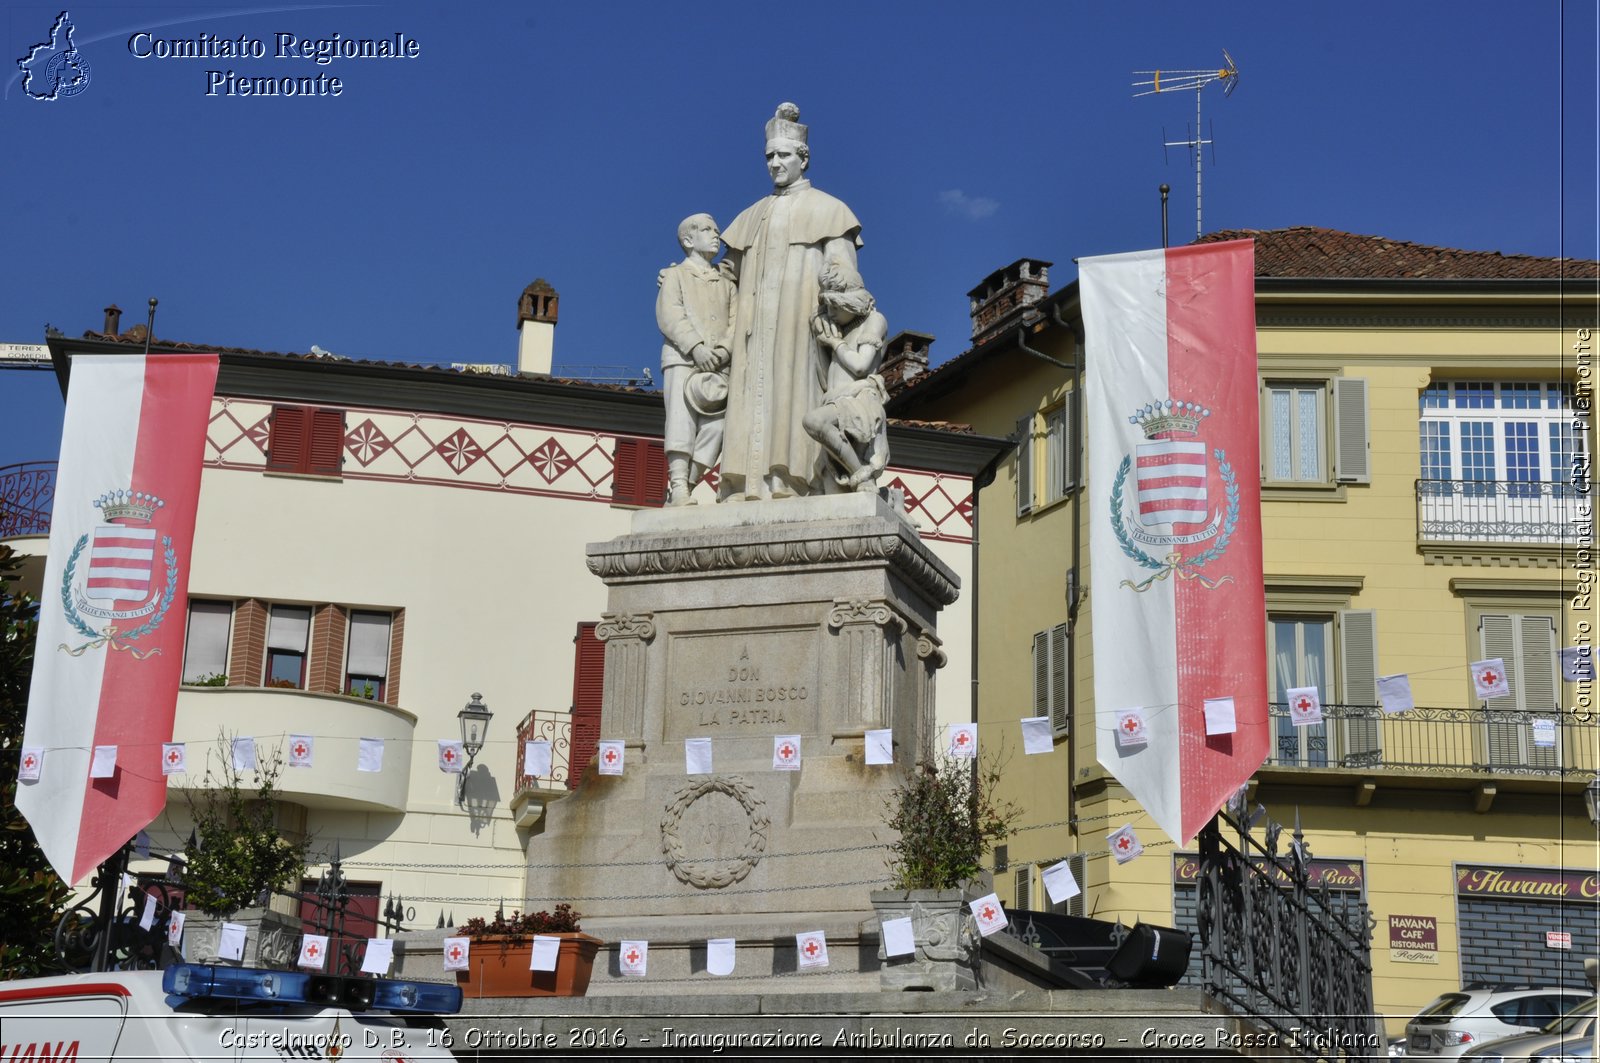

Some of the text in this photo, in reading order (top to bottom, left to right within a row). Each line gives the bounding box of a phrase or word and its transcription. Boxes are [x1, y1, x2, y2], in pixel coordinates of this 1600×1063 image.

[1192, 526, 1217, 540] TUTTO
[739, 643, 750, 661] A
[728, 667, 760, 683] DON
[679, 686, 809, 706] GIOVANNI BOSCO
[699, 709, 786, 727] LA PATRIA
[1318, 867, 1357, 885] Bar
[1467, 869, 1572, 897] Havana
[1391, 917, 1435, 930] HAVANA
[1401, 929, 1425, 939] CAFE'
[1391, 940, 1435, 950] RISTORANTE
[280, 1043, 323, 1061] 118
